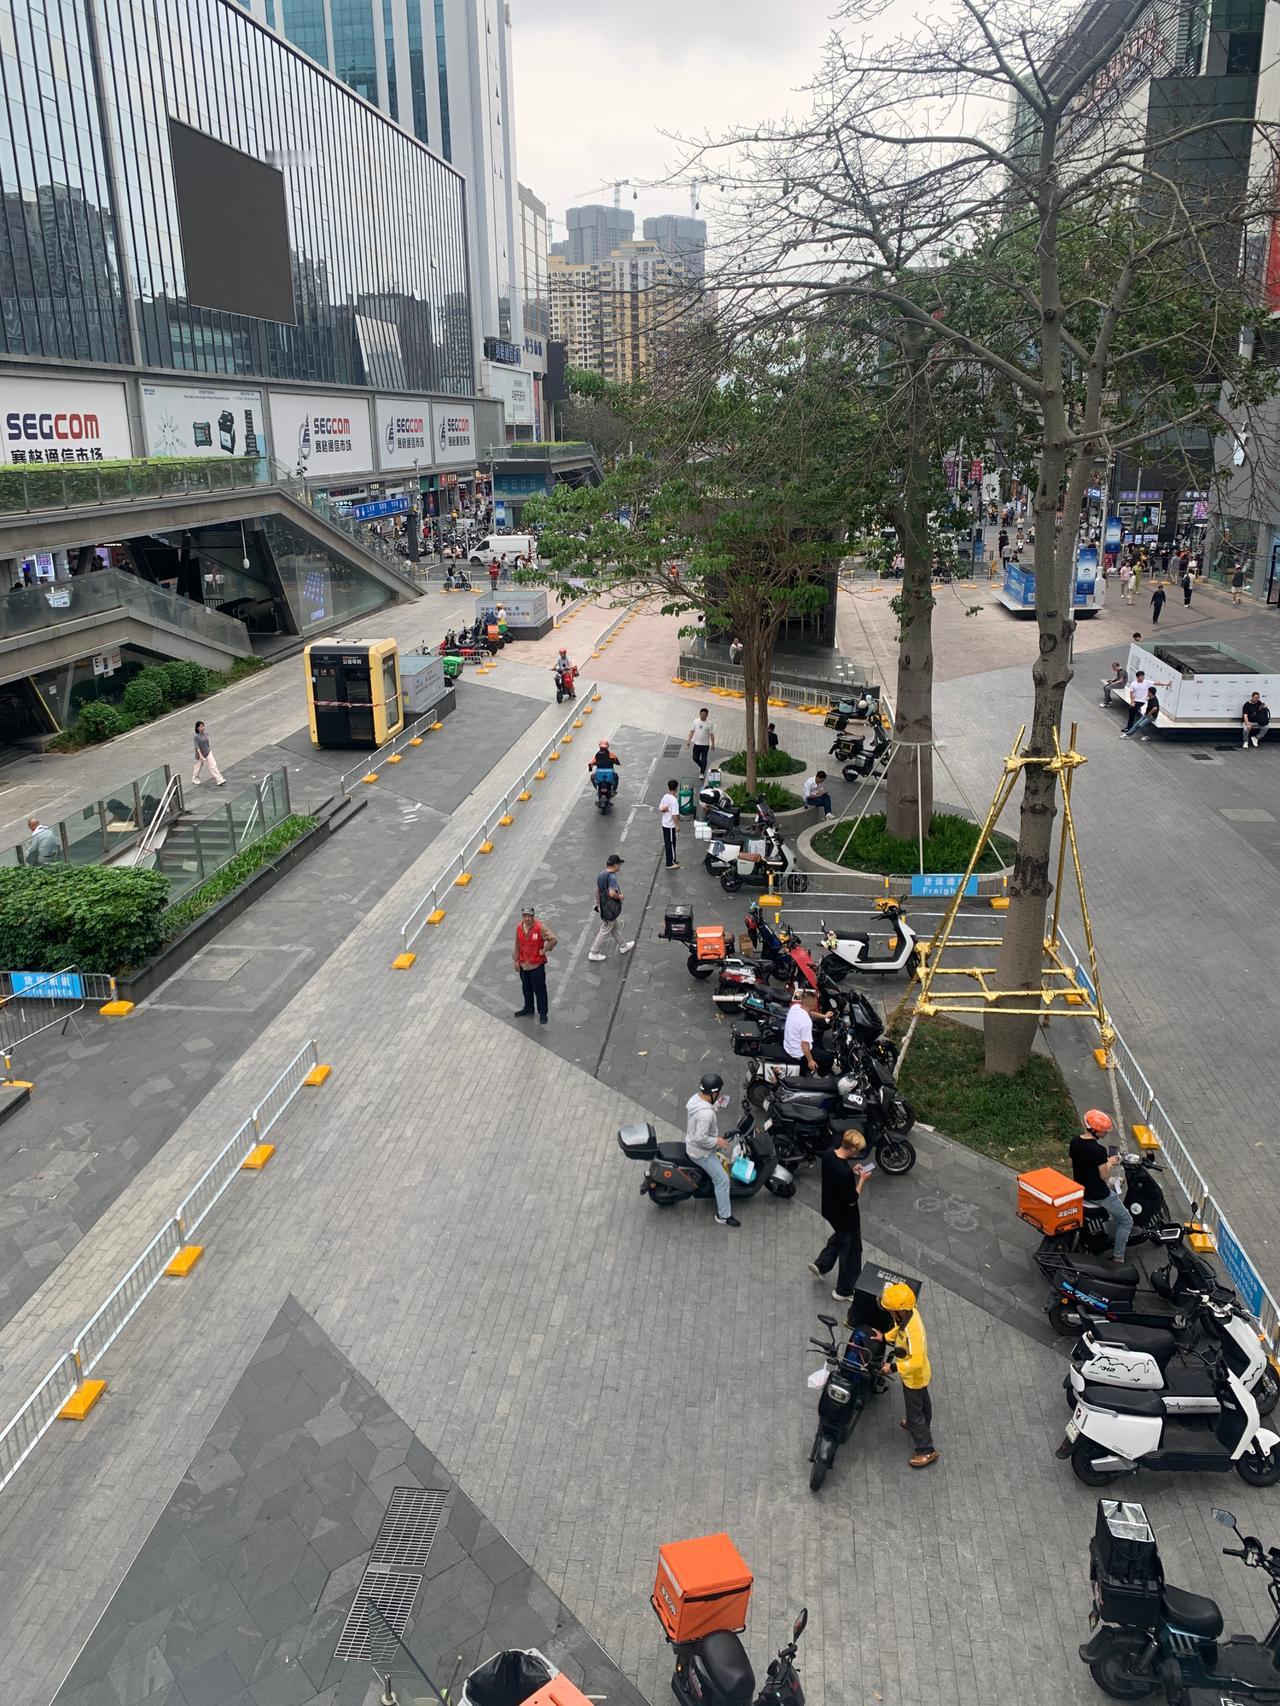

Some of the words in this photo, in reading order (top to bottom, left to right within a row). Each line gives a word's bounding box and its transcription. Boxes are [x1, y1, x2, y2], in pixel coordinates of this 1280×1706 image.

[6, 413, 100, 440] SEGCOM
[313, 417, 351, 435] SEGCOM
[396, 418, 424, 433] SEGCOM
[447, 418, 470, 433] SEGCOM
[315, 439, 352, 453] 赛格通信市场
